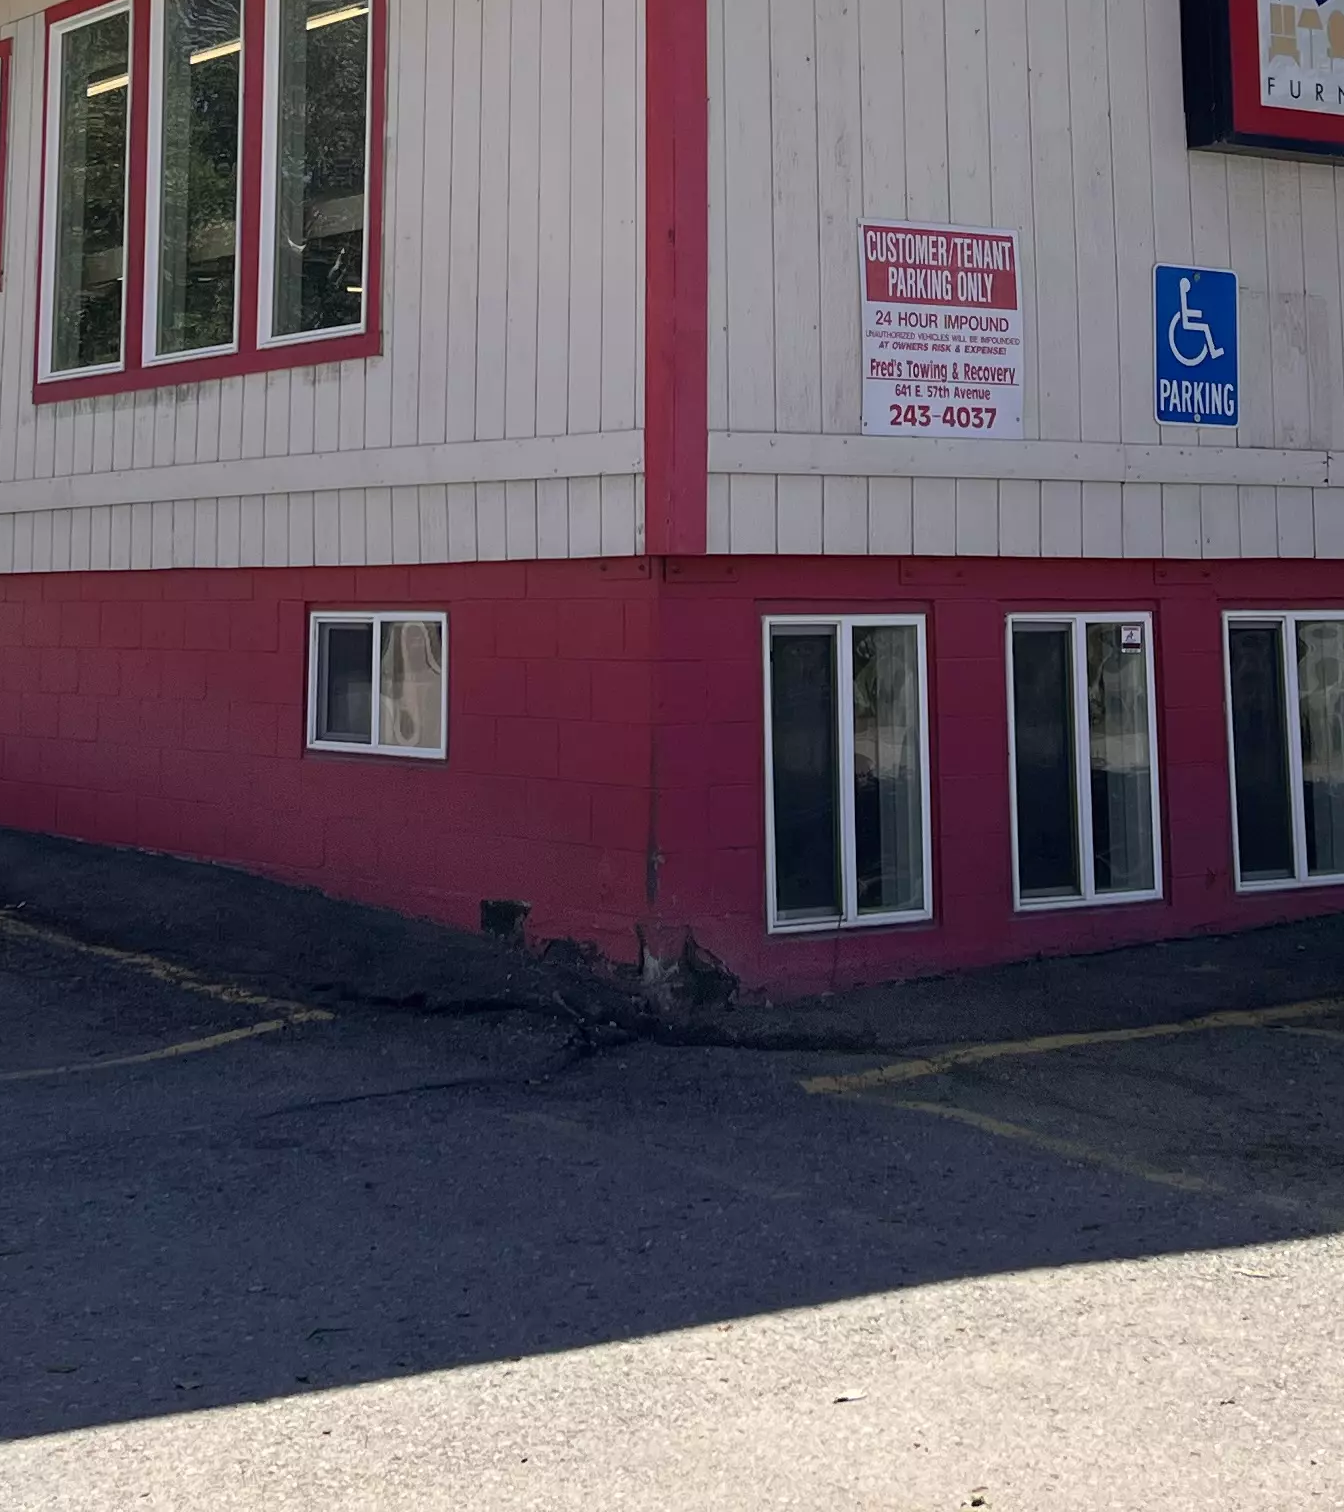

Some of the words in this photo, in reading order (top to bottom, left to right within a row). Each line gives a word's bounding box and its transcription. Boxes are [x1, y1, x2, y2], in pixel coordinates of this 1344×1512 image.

[866, 230, 1012, 271] CUSTOMER/TENANT
[888, 266, 952, 301] PARKING
[957, 271, 994, 303] ONLY
[875, 310, 893, 327] 24
[898, 311, 938, 329] HOUR
[944, 314, 1009, 333] IMPOUND
[865, 329, 916, 340] UNAUTHORIZED
[918, 332, 950, 342] VEHICLES
[952, 334, 969, 343] WILL
[970, 335, 979, 344] BE
[878, 341, 890, 349] AT
[892, 342, 929, 352] OWNERS
[931, 344, 951, 353] RISK
[954, 345, 961, 353] &
[870, 358, 903, 378] Fred's
[906, 360, 948, 382] Towing
[952, 363, 958, 380] &
[963, 363, 1016, 385] Recovery
[895, 383, 912, 397] 641
[914, 385, 923, 398] E.
[927, 385, 950, 399] 57th
[953, 386, 991, 400] Avenue
[1159, 378, 1235, 417] PARKING
[889, 404, 997, 429] 243-4037
